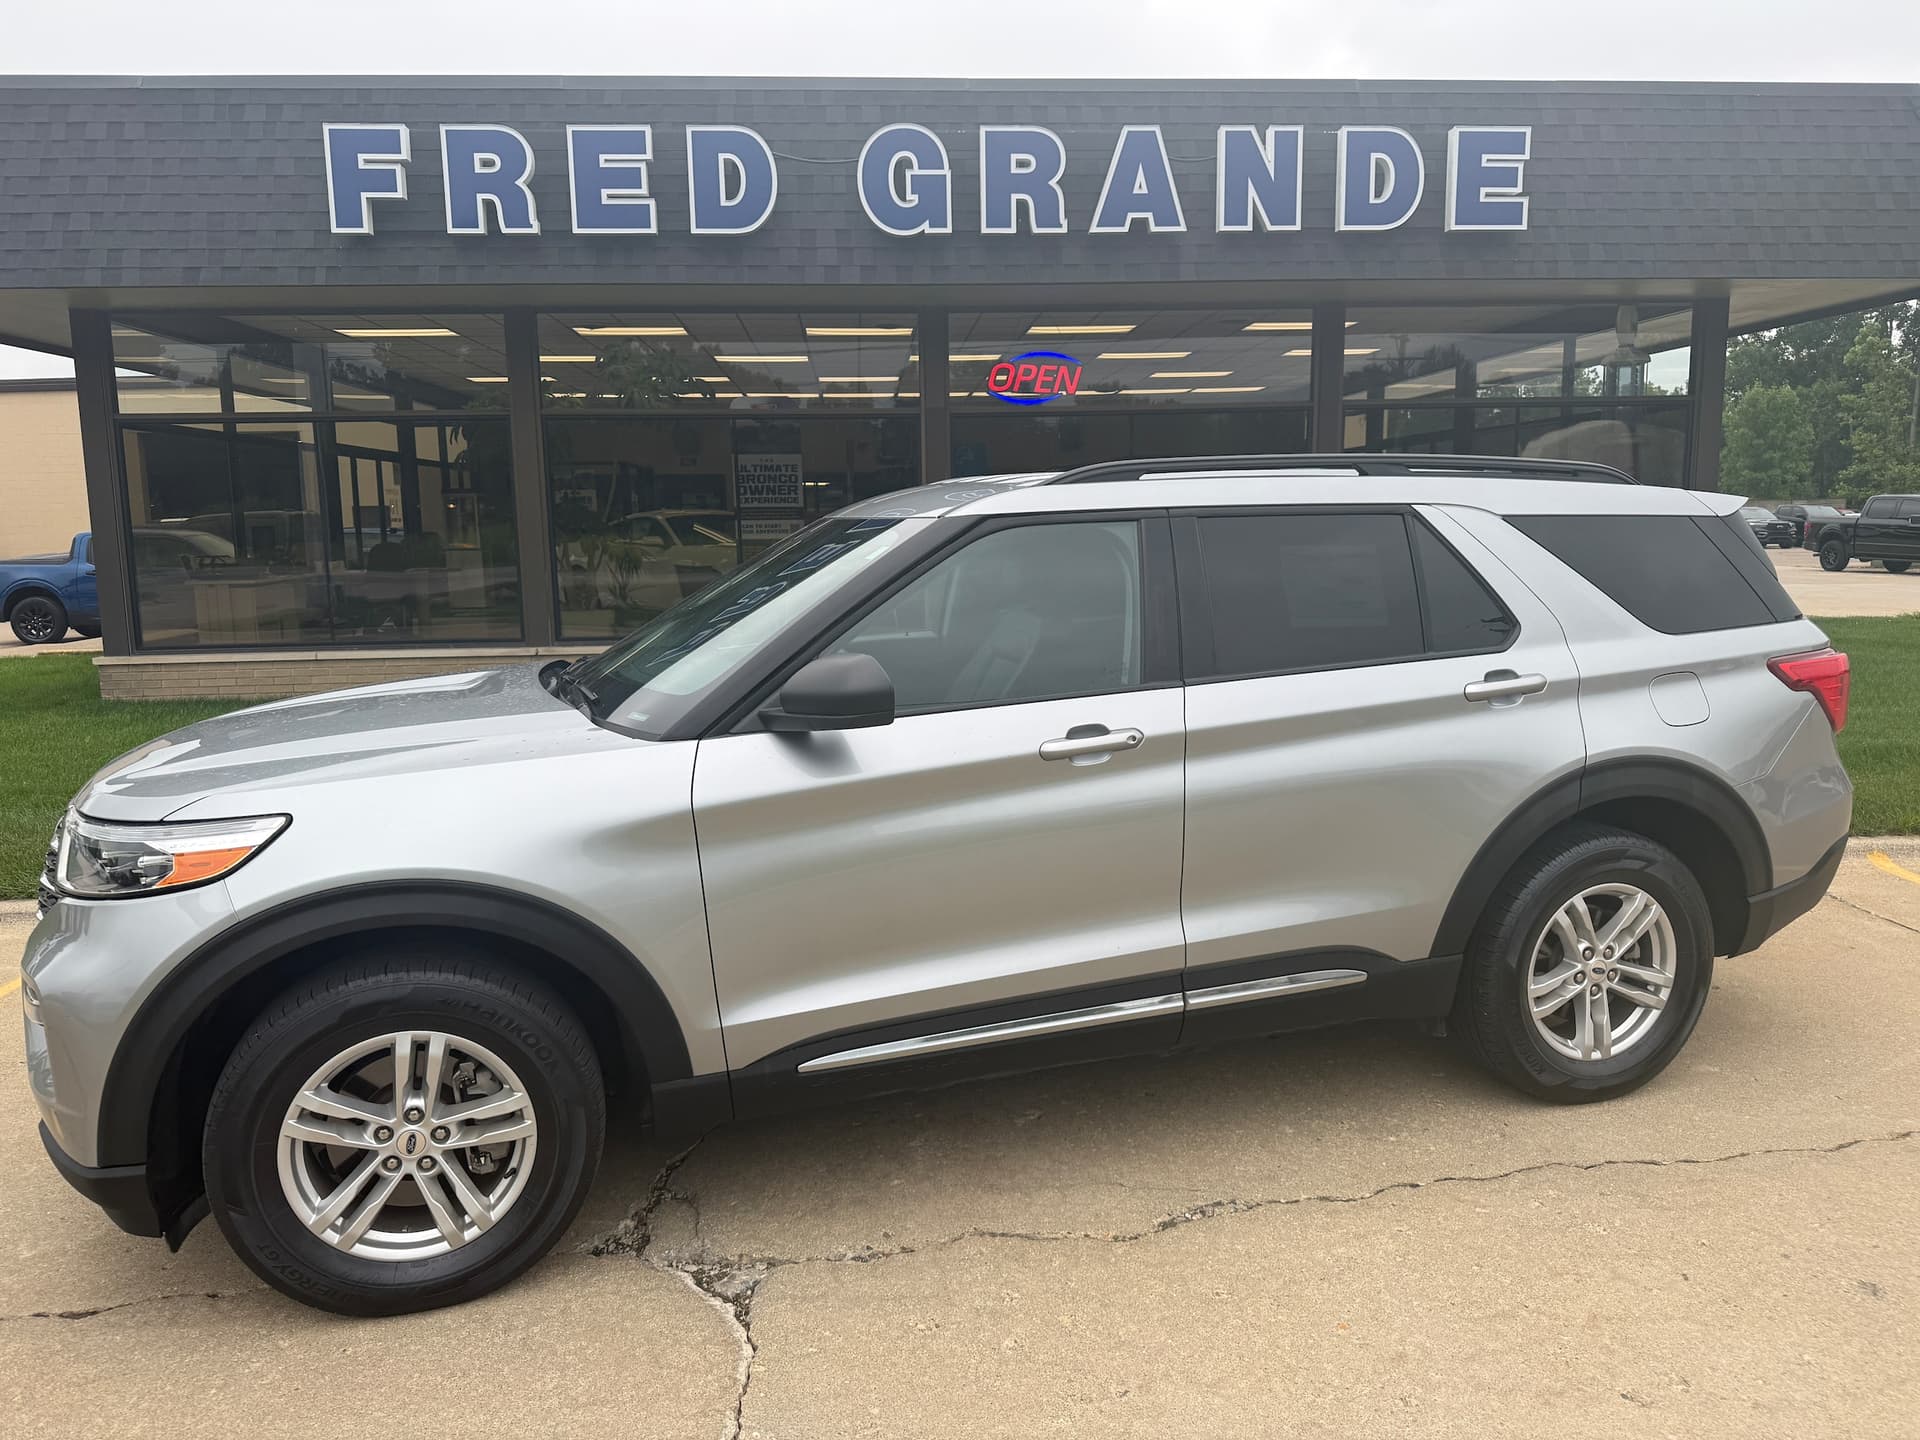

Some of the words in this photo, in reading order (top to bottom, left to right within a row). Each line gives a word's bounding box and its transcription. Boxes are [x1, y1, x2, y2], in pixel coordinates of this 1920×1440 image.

[322, 122, 778, 235] FRED
[857, 122, 1532, 235] GRANDE
[988, 362, 1083, 394] OPEN
[737, 473, 799, 484] BRONCO
[736, 484, 799, 496] OWNER
[740, 496, 800, 505] XPERIENCE
